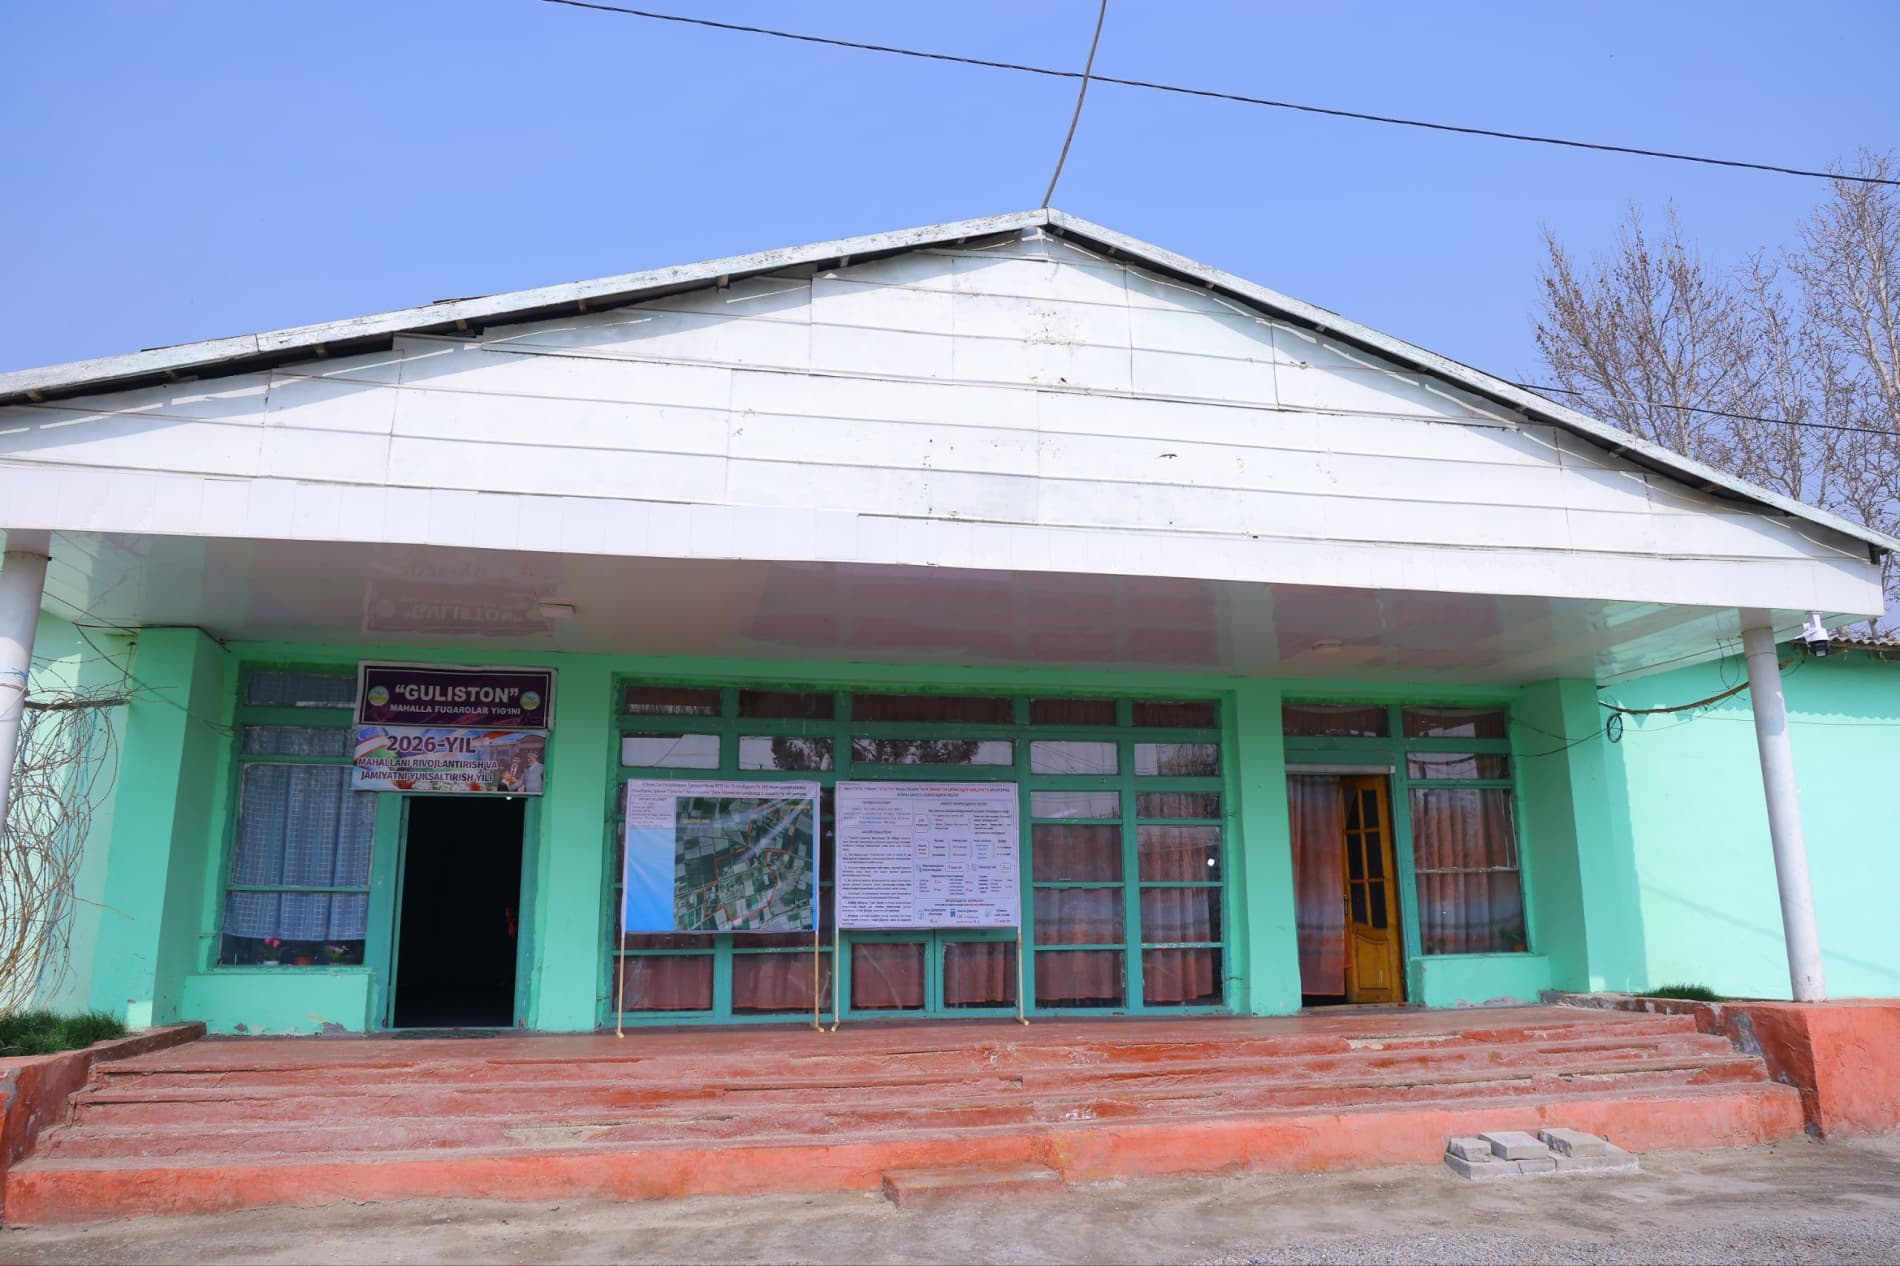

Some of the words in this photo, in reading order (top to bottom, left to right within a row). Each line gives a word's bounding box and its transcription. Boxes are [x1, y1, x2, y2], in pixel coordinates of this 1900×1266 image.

[395, 684, 519, 703] “GULISTON”
[390, 703, 432, 713] MAHALLA
[434, 705, 489, 715] FUQAROLAR
[386, 735, 476, 753] 2026-YIL
[358, 758, 410, 768] MAHALLANI
[412, 759, 486, 769] RIVOJLANTIRISH
[486, 760, 498, 769] VA
[360, 771, 408, 781] JAMIYATNI
[409, 772, 474, 782] YUKSALTIRISH
[476, 774, 493, 782] YILI
